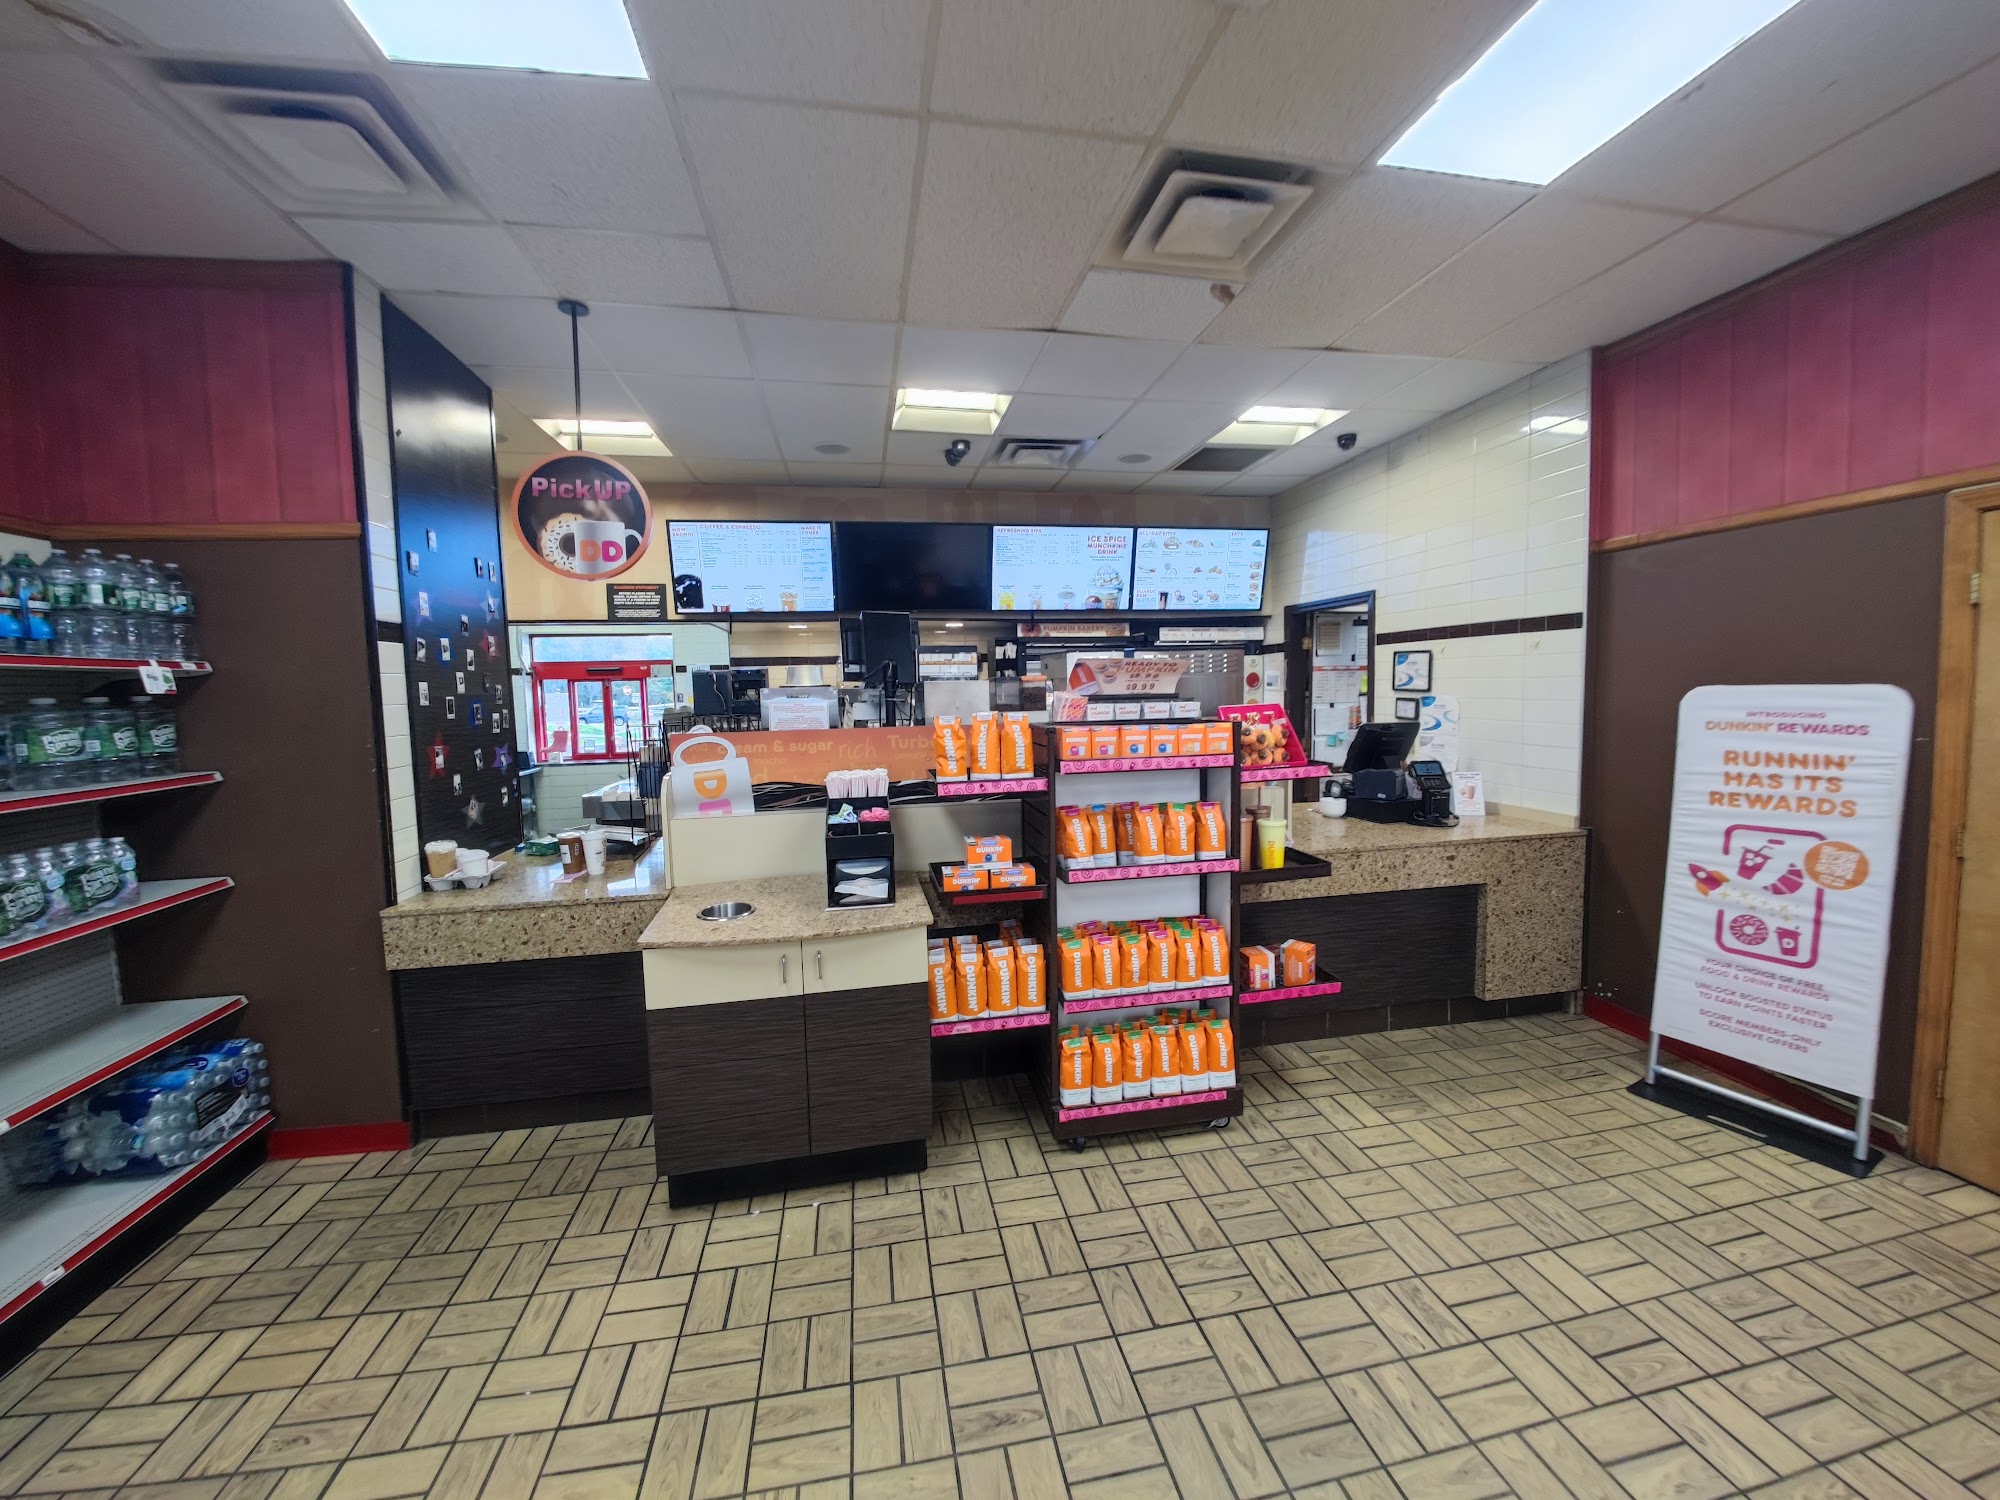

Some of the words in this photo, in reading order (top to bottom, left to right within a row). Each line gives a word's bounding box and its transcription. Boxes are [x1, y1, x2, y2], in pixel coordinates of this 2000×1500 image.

[1746, 711, 1826, 719] INTRODUCING
[1777, 722, 1870, 736] REWARDS
[718, 743, 767, 753] ceam
[773, 740, 784, 753] &
[789, 741, 834, 755] sugar
[839, 736, 877, 760] rich
[1723, 750, 1856, 771] RUNNIN'
[1723, 771, 1784, 789] HAS
[1794, 775, 1844, 793] ITS
[1708, 791, 1858, 818] REWARDS
[976, 846, 1004, 854] DUNKIN'
[952, 877, 981, 885] DUNKIN'
[1000, 875, 1029, 883] DUNKIN'
[966, 965, 978, 1012] DUNKIN'
[998, 959, 1011, 1007] DUNKIN'
[1027, 956, 1038, 1003] DUNKIN'
[1700, 965, 1729, 978] FOOD
[1742, 975, 1774, 988] DRINK
[1777, 983, 1830, 1001] REWARDS
[1705, 958, 1733, 969] YOUR
[1735, 964, 1777, 980] CHOICE
[1779, 975, 1794, 983] OF
[1797, 979, 1824, 991] FREE
[934, 967, 948, 1015] DUNKIN'
[1695, 981, 1736, 997] UNLOCK
[1740, 992, 1790, 1011] BOOSTED
[1792, 1005, 1833, 1022] STATUS
[1698, 990, 1712, 1000] TO
[1714, 995, 1741, 1008] EARN
[1743, 1002, 1783, 1019] POINTS
[1786, 1013, 1827, 1029] FASTER
[1699, 1008, 1733, 1024] SCORE
[1735, 1018, 1823, 1047] MEMBERS-ONLY
[1708, 1019, 1763, 1041] EXCLUSIVE
[1766, 1036, 1809, 1053] OFFERS
